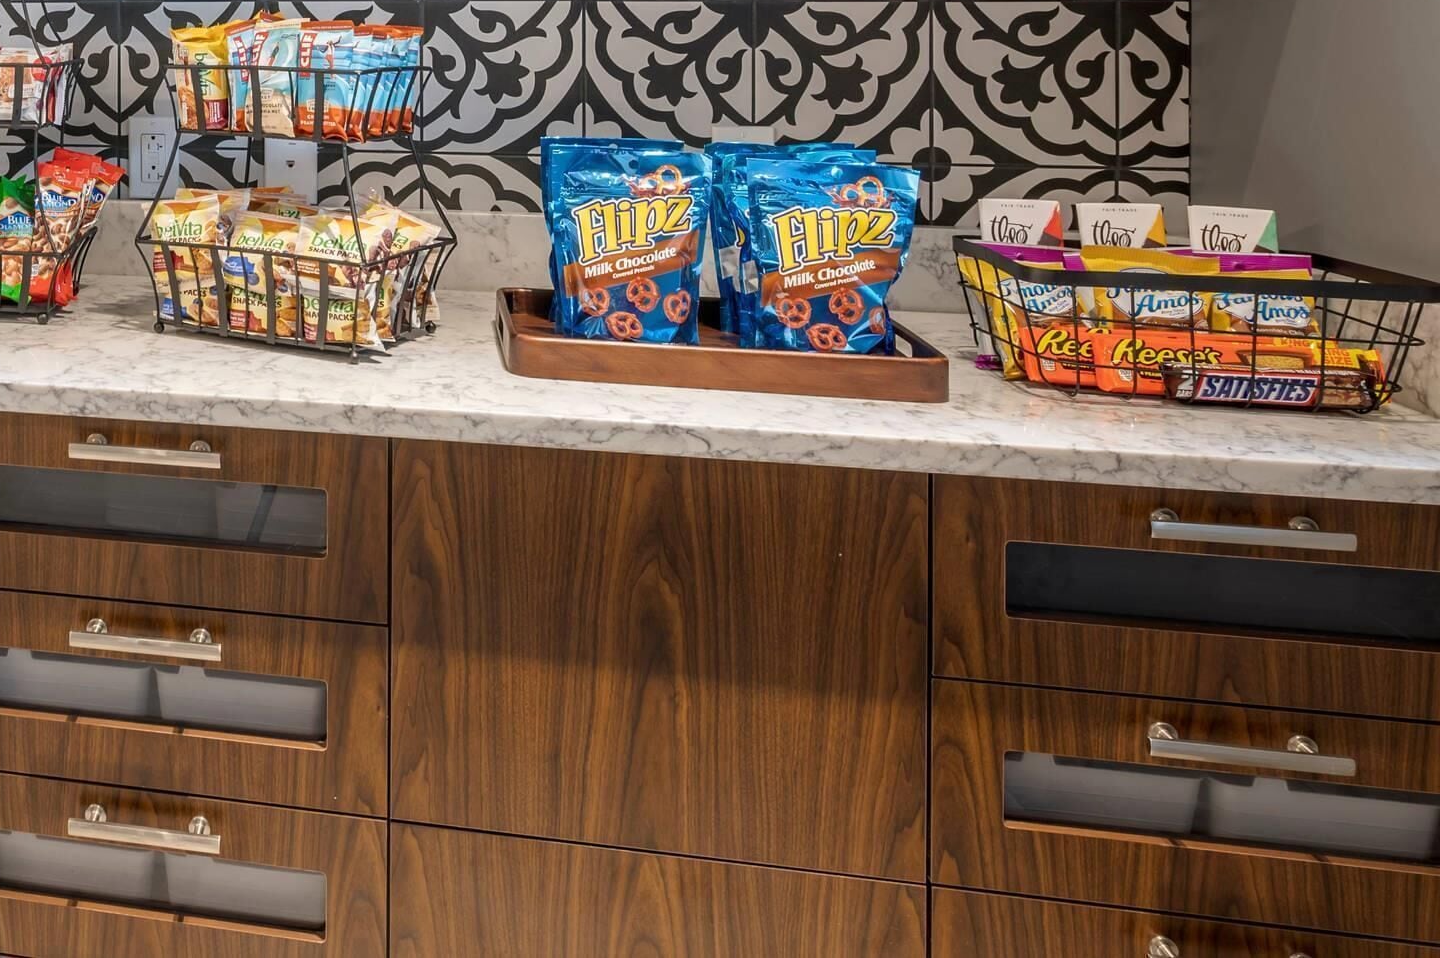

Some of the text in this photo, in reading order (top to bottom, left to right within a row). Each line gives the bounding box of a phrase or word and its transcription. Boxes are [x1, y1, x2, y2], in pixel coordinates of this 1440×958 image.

[301, 33, 314, 67] CLIF
[8, 216, 32, 224] BLUE
[574, 196, 693, 265] Flipz
[990, 215, 1033, 244] theo
[772, 207, 896, 274] Flipz
[1091, 220, 1136, 248] theo
[1200, 224, 1248, 253] theo
[308, 246, 361, 259] SNACK PACK
[584, 247, 677, 278] Milk Chocolate
[612, 265, 655, 279] Covered Pretzels
[783, 259, 876, 289] Milk Chocolate
[814, 276, 859, 289] Covered Pretzels
[1026, 286, 1075, 314] Amos
[1136, 292, 1203, 317] Amos
[1244, 301, 1311, 325] Amos
[328, 312, 355, 321] PACKS
[1112, 338, 1223, 366] Reese's
[1175, 390, 1193, 398] BARS
[1177, 371, 1194, 391] 2
[1198, 375, 1318, 402] SATISFIES
